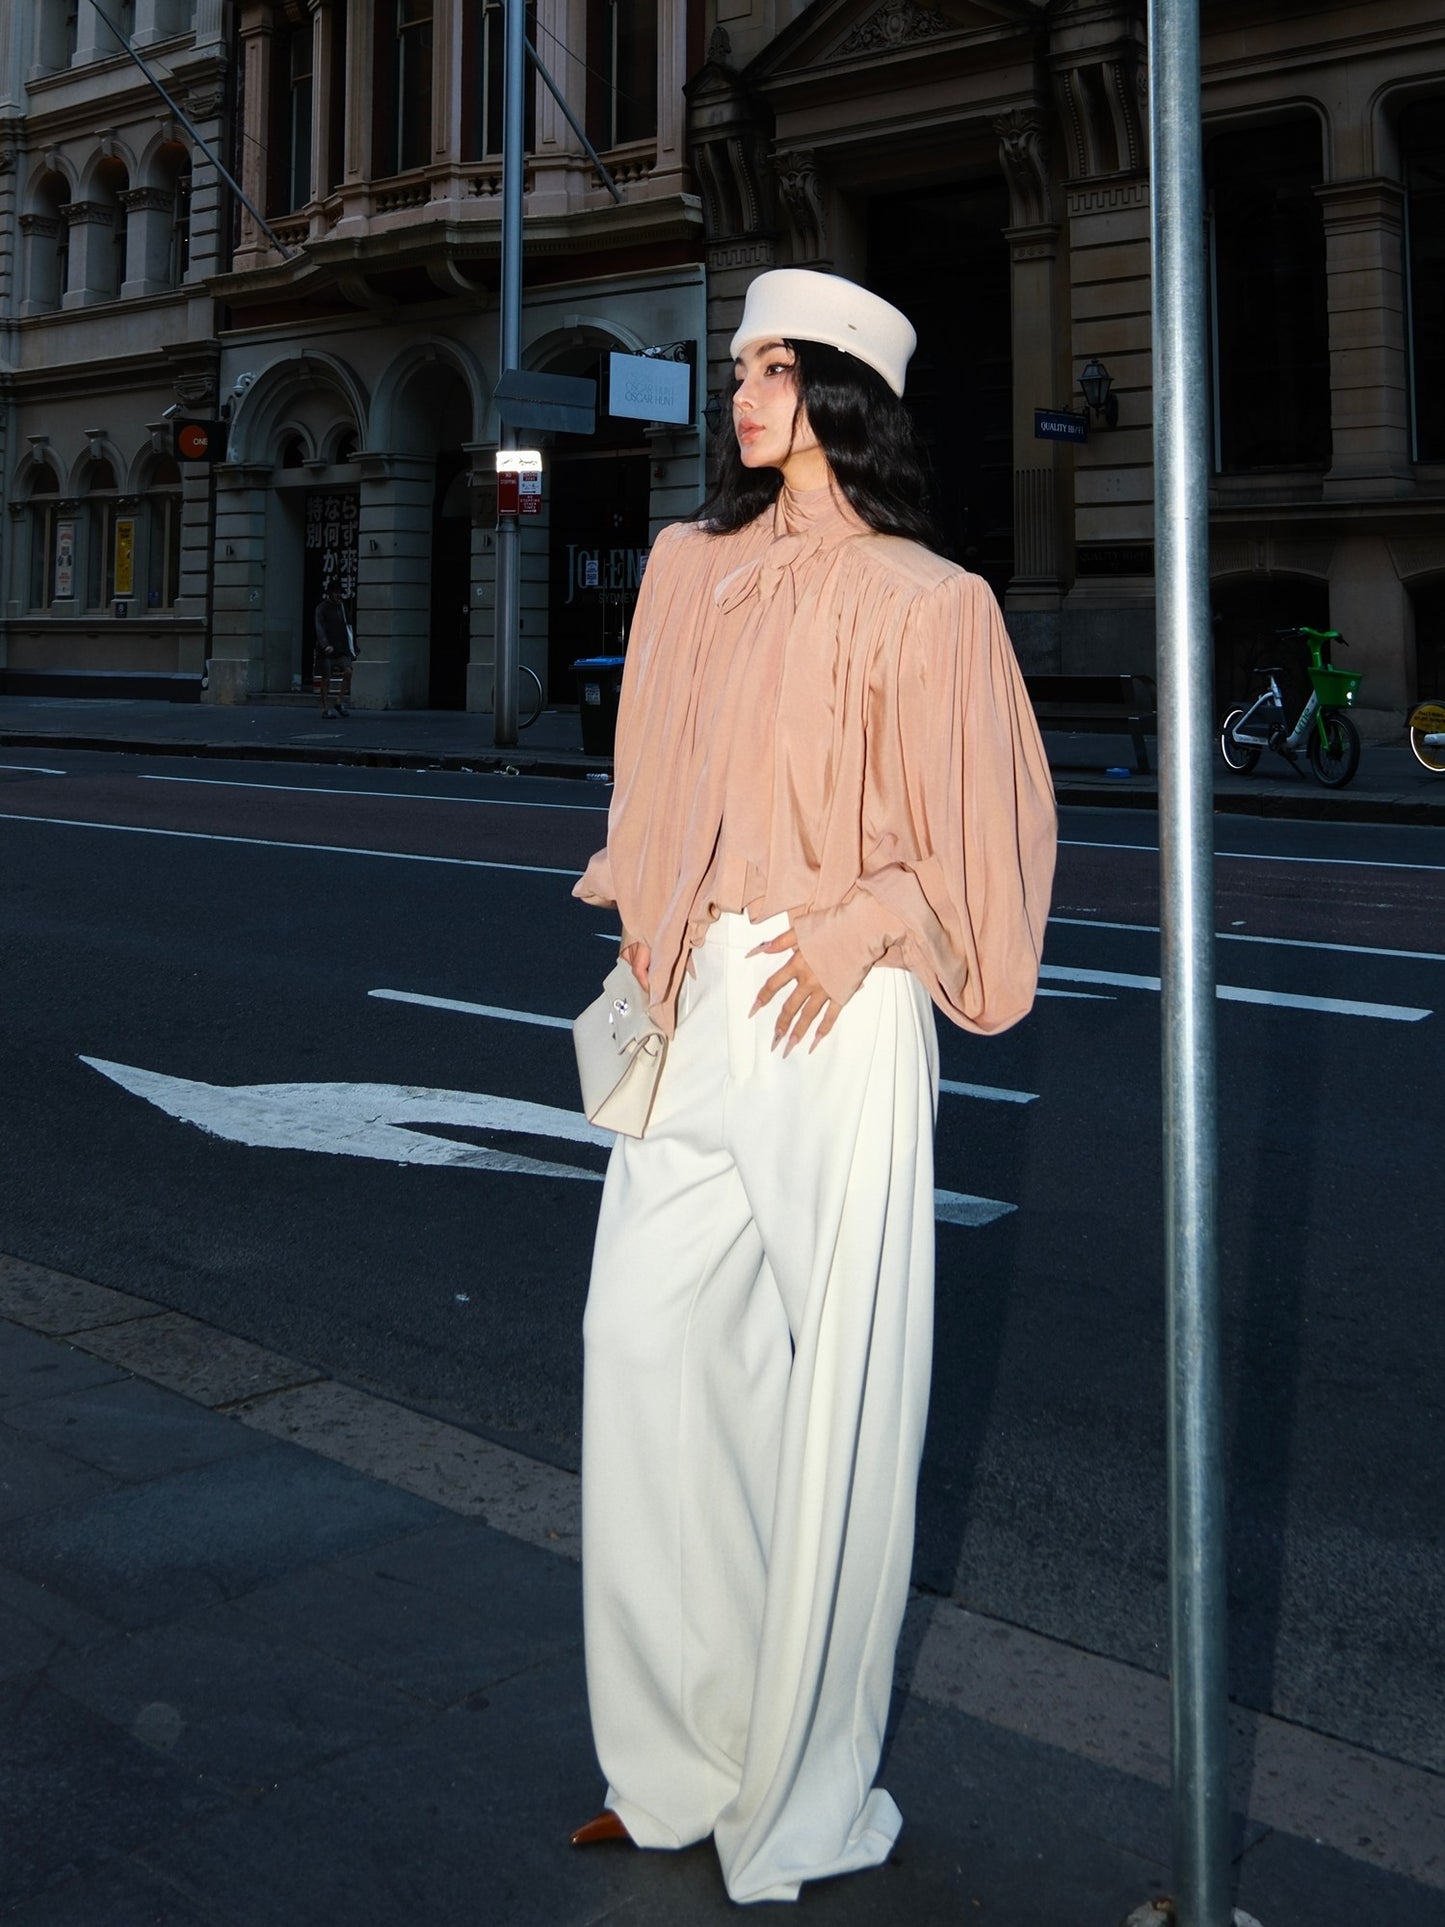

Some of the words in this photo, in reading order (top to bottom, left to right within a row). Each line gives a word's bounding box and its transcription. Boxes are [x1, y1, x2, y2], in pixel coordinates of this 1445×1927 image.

[625, 391, 653, 404] OSCAR
[655, 395, 674, 406] HUNT
[1041, 421, 1067, 433] QUALITY
[305, 496, 323, 549] 特別
[563, 544, 649, 605] JOLEN
[598, 592, 636, 605] SYDNEY
